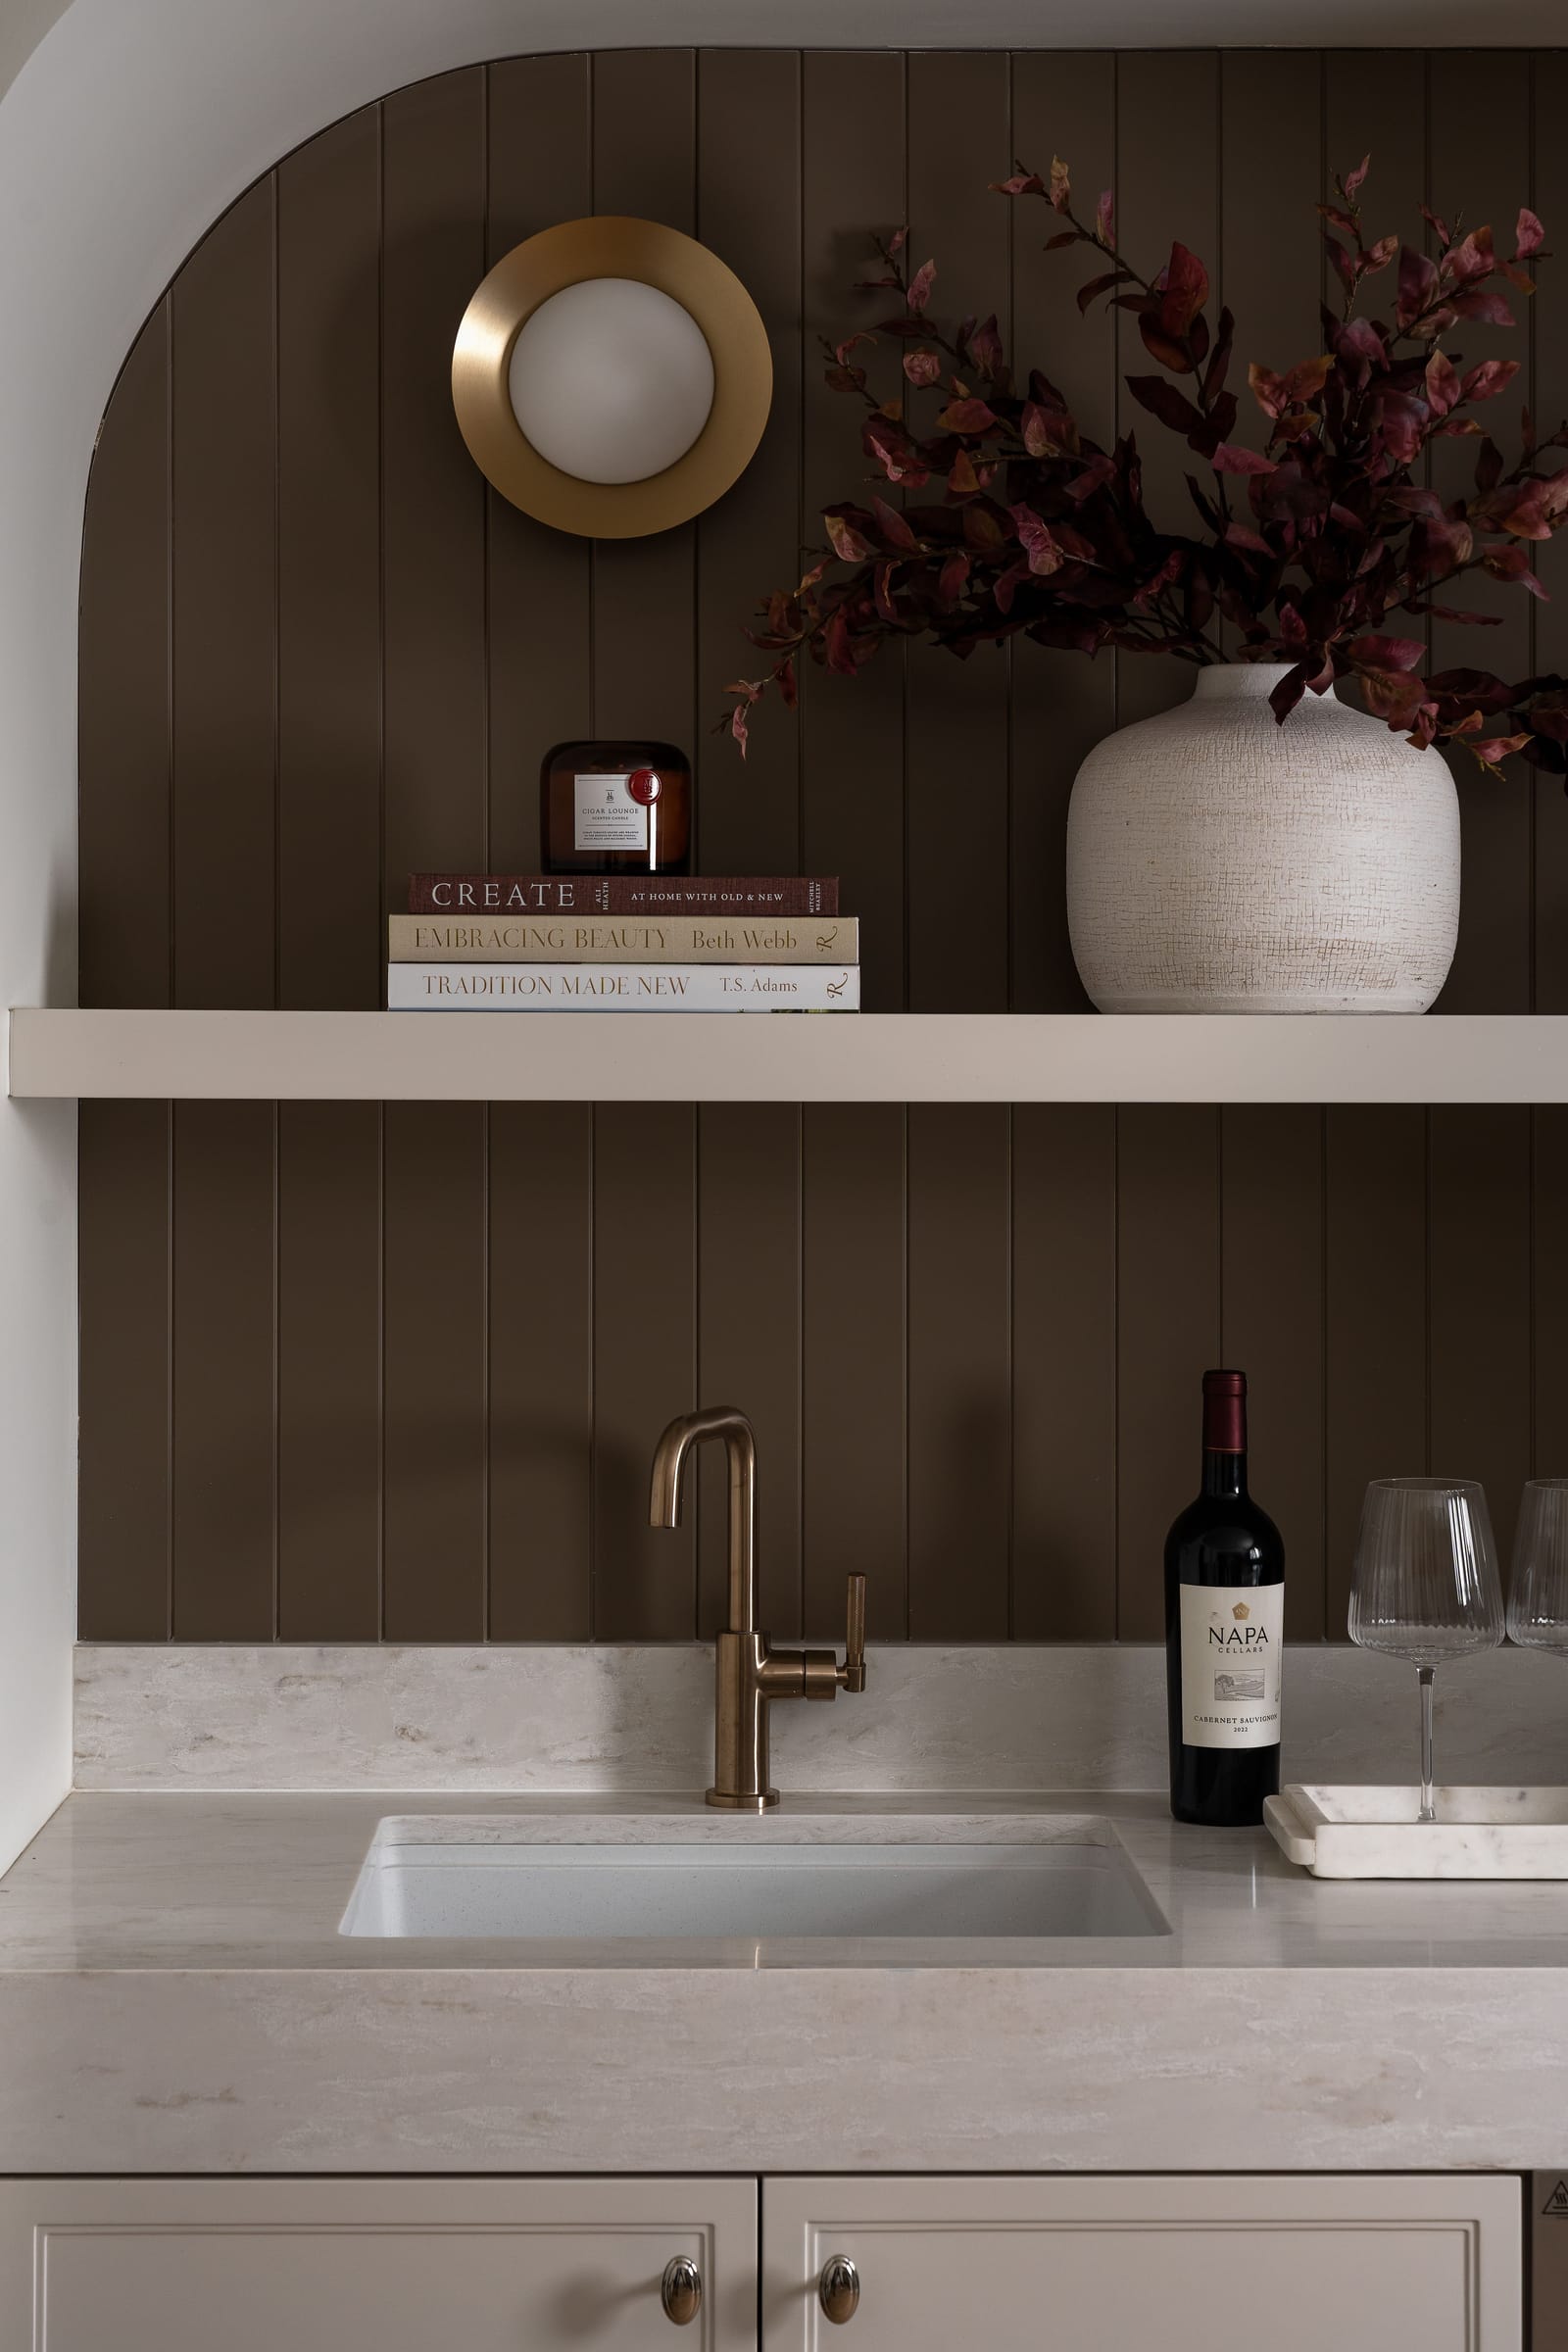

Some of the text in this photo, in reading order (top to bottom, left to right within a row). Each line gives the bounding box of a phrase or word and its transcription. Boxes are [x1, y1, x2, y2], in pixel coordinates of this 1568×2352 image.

[432, 883, 575, 906] CREATE
[720, 893, 744, 902] OLD
[747, 893, 754, 902] &
[758, 893, 784, 902] NEW
[415, 927, 797, 950] EMBRACING BEAUTY Beth Webb
[422, 975, 798, 996] TRADITION MADE NEW T.S. Adams
[1208, 1626, 1269, 1644] NAPA
[1194, 1714, 1278, 1724] CABERNET SAUVIGNON
